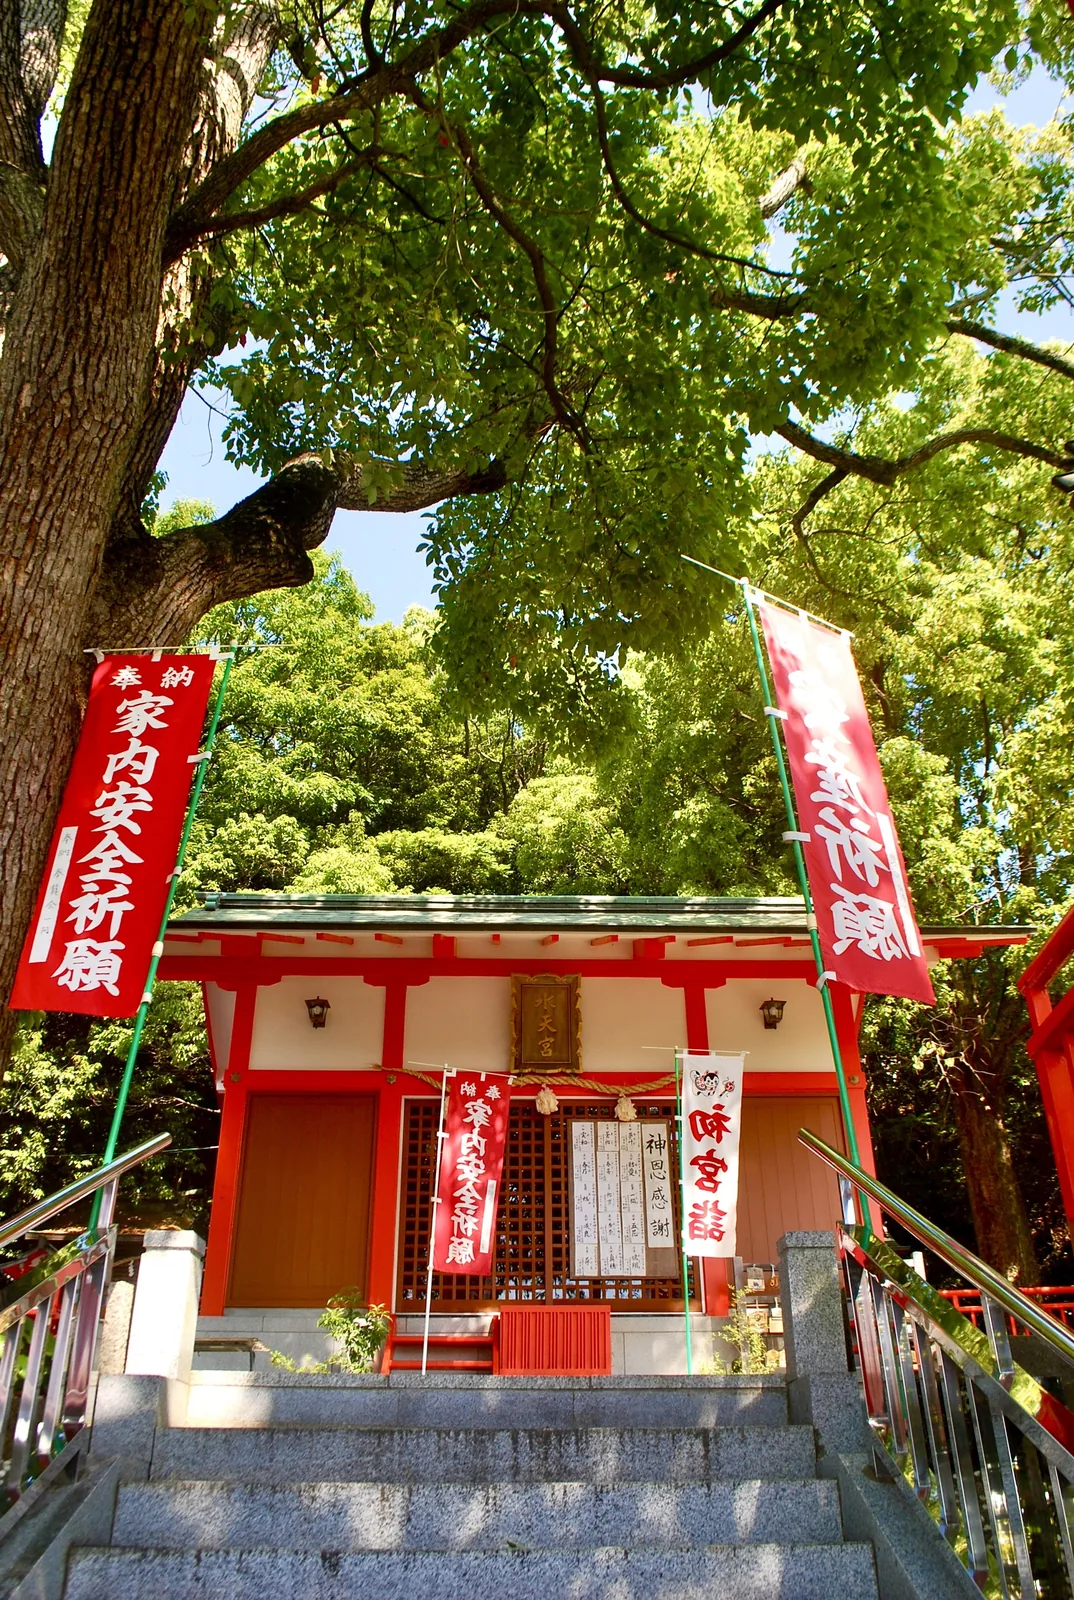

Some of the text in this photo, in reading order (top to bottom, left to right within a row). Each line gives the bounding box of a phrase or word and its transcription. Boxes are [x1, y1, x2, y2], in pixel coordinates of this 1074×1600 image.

[109, 664, 195, 691] 奉納
[51, 689, 174, 997] 家内安全祈願
[534, 991, 558, 1057] 水天宮
[645, 1133, 670, 1238] 神恩感謝
